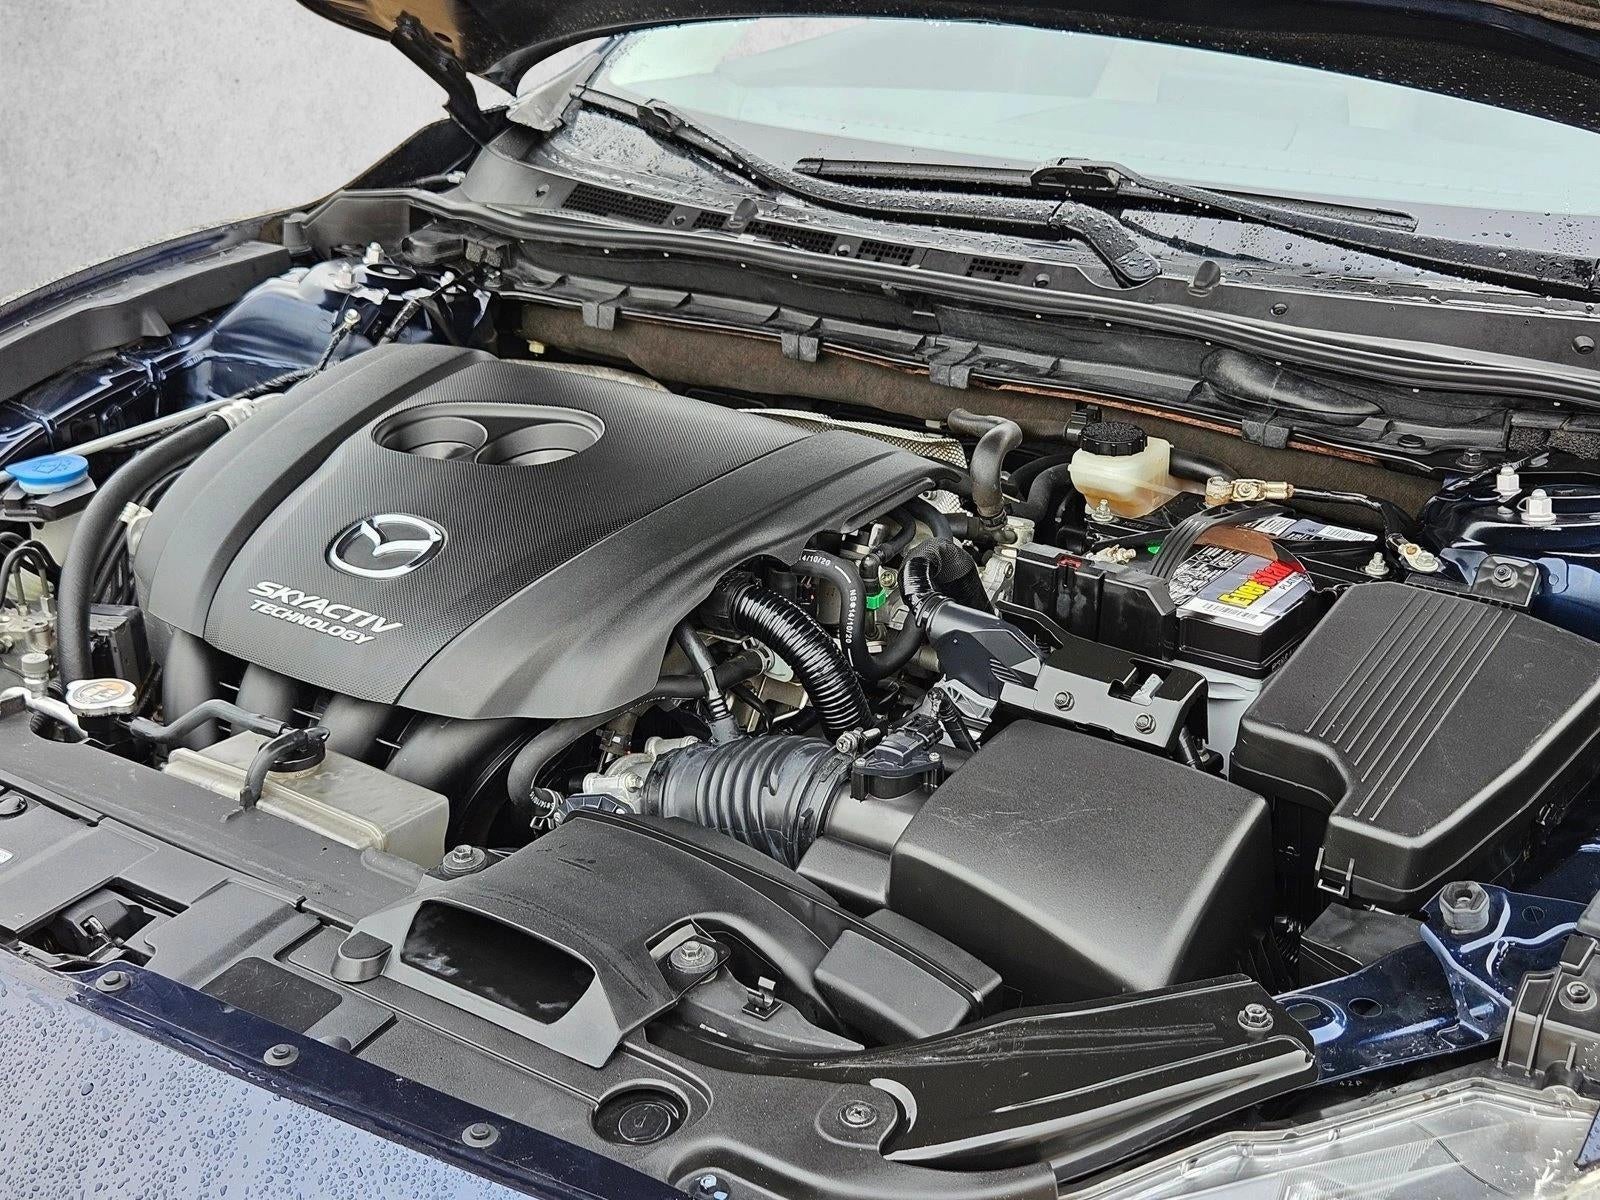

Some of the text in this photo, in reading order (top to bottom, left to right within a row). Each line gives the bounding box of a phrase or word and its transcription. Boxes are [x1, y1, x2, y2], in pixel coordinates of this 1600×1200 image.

[801, 554, 831, 566] 4/10/20
[248, 581, 404, 634] SKYACTIV
[249, 599, 376, 645] TECHNOLOGY
